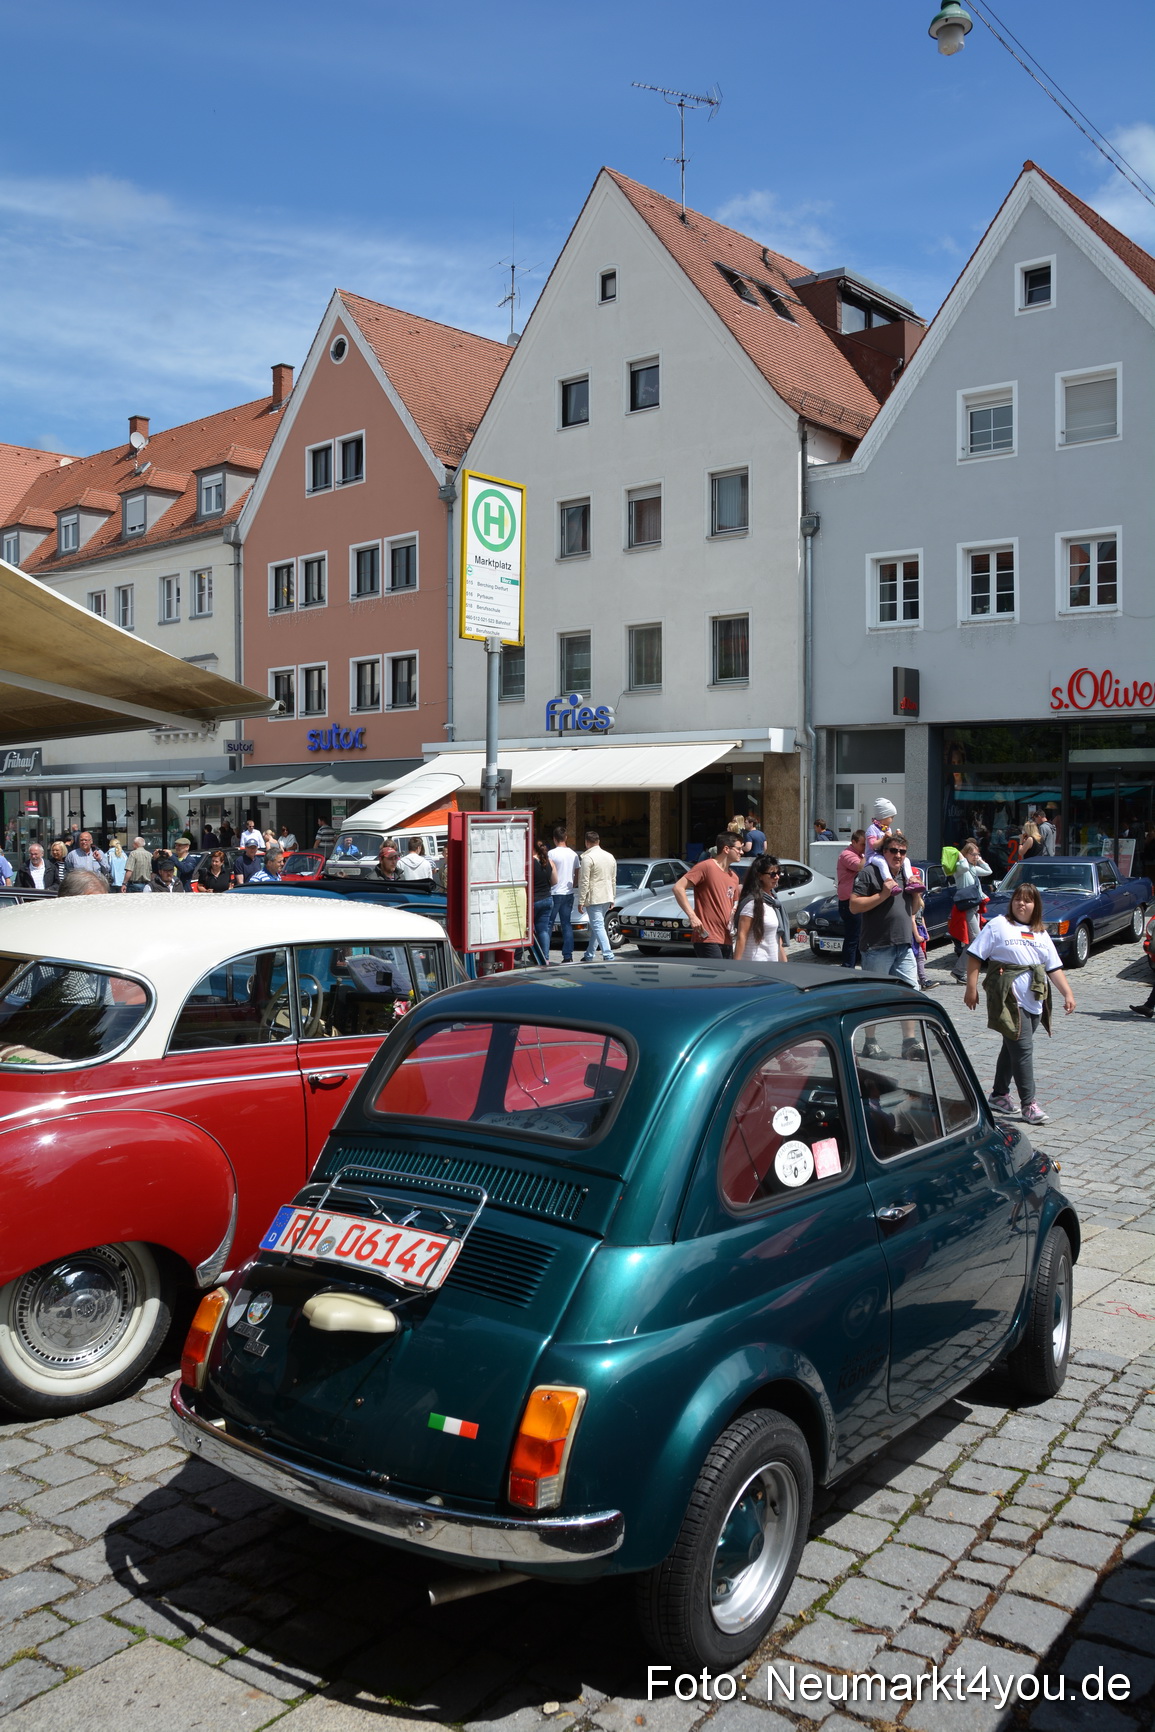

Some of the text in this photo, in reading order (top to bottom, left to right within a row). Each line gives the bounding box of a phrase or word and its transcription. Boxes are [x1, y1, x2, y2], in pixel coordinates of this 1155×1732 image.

[484, 502, 504, 539] H
[475, 555, 512, 571] Marktplatz
[1050, 667, 1155, 710] s.Olive
[546, 693, 615, 731] fries
[227, 742, 254, 752] sutor
[307, 723, 367, 751] sutor
[0, 750, 40, 773] frühauf
[268, 1232, 277, 1242] D
[281, 1214, 447, 1278] RH 06147
[236, 1323, 261, 1338] FIAT
